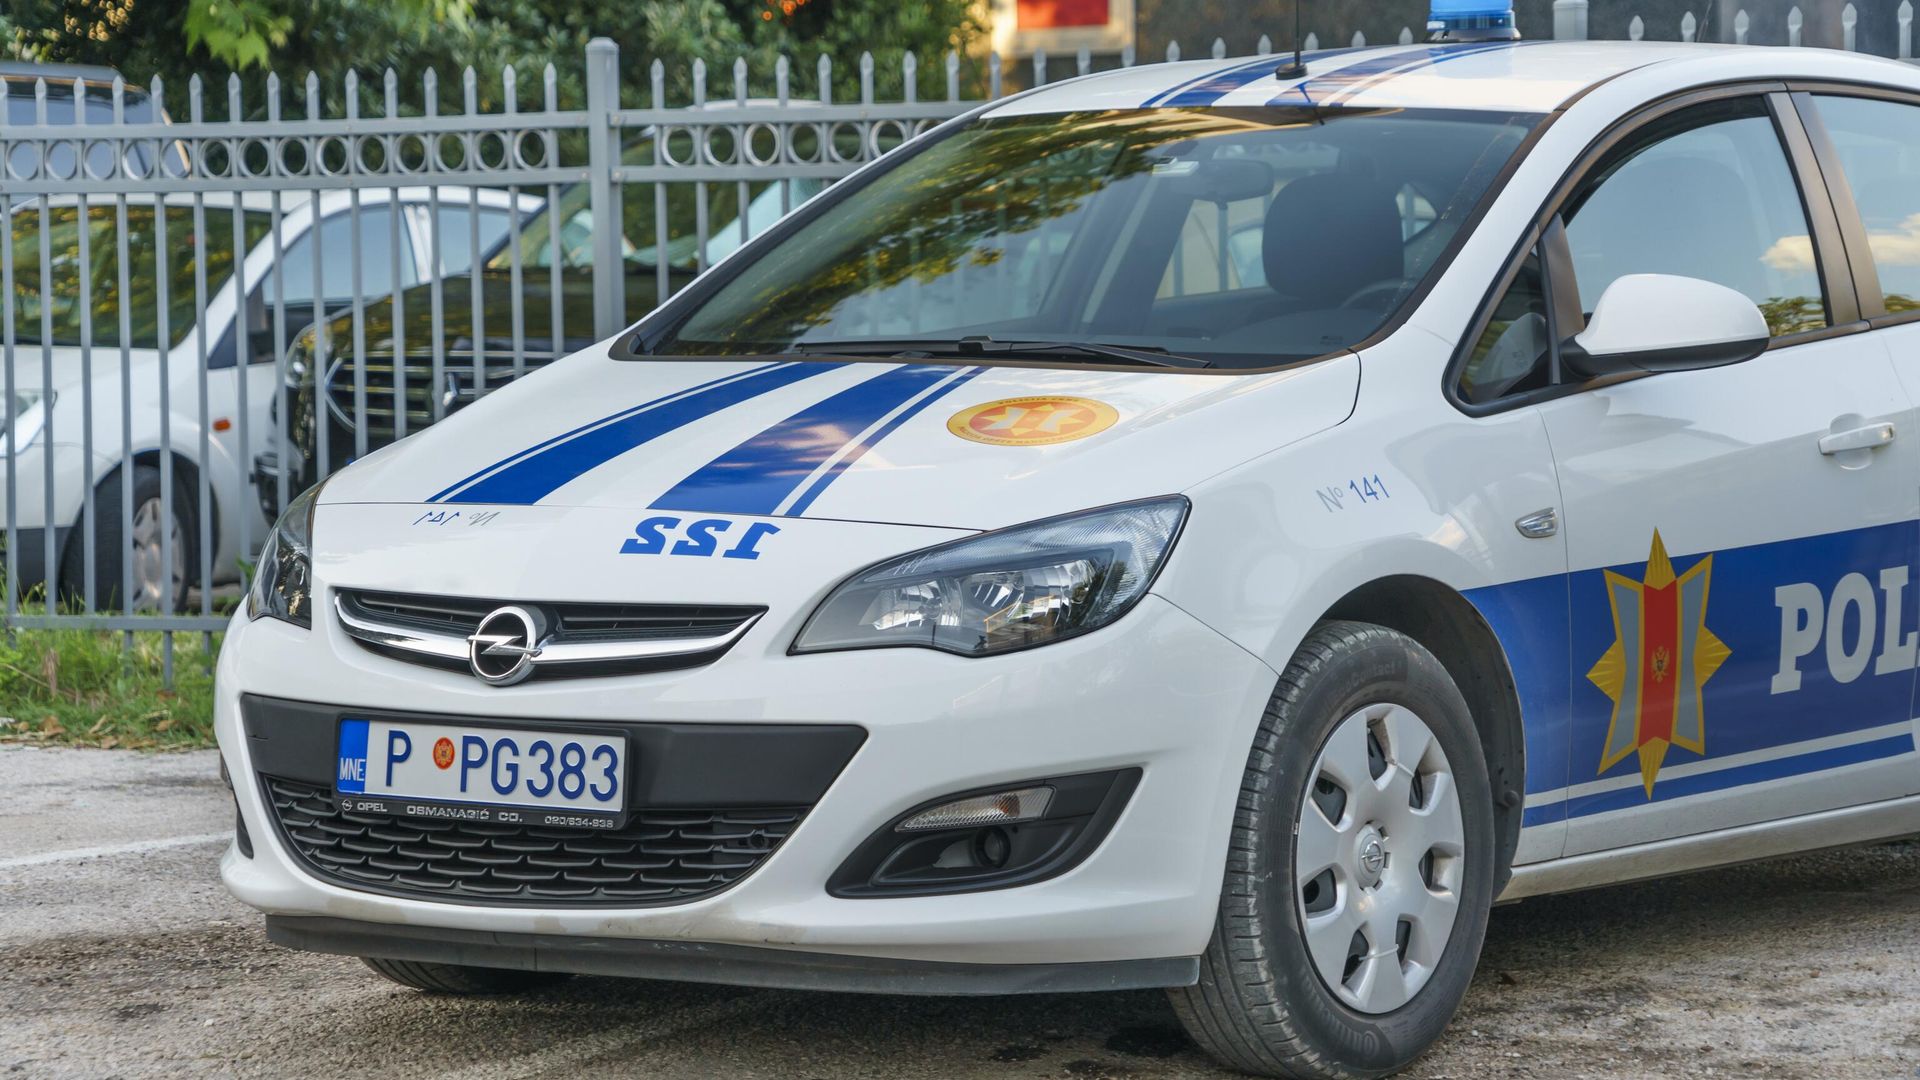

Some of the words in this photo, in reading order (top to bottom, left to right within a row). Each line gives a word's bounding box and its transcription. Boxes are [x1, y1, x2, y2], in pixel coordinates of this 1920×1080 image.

[1349, 474, 1390, 503] 141
[339, 757, 366, 782] MNE
[386, 730, 412, 787] P
[460, 735, 618, 801] PG383
[357, 803, 388, 812] OPEL
